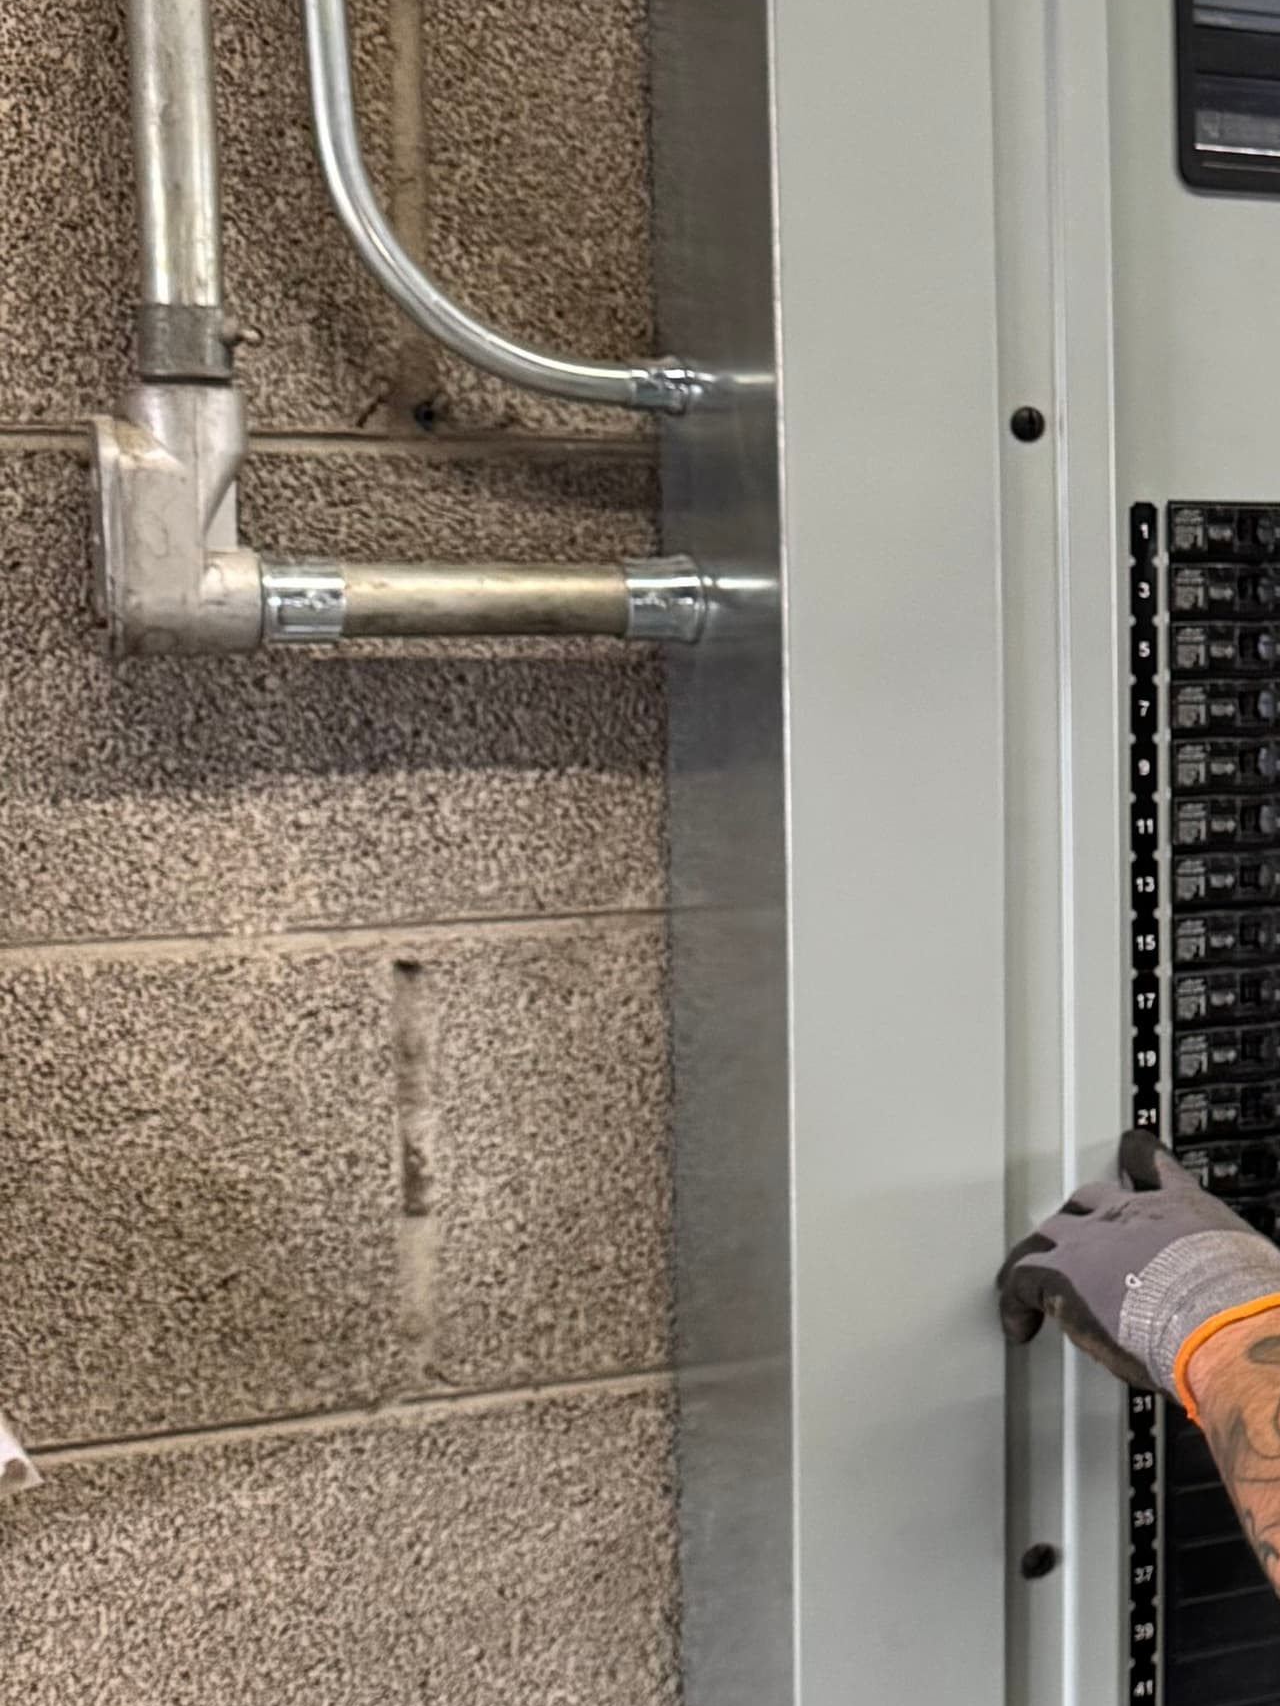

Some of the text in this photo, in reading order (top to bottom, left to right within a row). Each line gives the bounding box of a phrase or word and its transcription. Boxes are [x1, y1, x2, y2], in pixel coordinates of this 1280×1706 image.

[1140, 522, 1149, 539] 1
[1138, 582, 1150, 599] 3
[1138, 641, 1150, 658] 5
[1138, 699, 1150, 717] 7
[1138, 759, 1150, 776] 9
[1136, 818, 1154, 834] 11
[1136, 876, 1155, 893] 13
[1136, 934, 1155, 951] 15
[1136, 992, 1156, 1009] 17
[1137, 1050, 1156, 1067] 19
[1138, 1108, 1157, 1126] 21
[1133, 1395, 1153, 1413] 31
[1133, 1564, 1154, 1584] 37
[1133, 1679, 1154, 1697] 41
